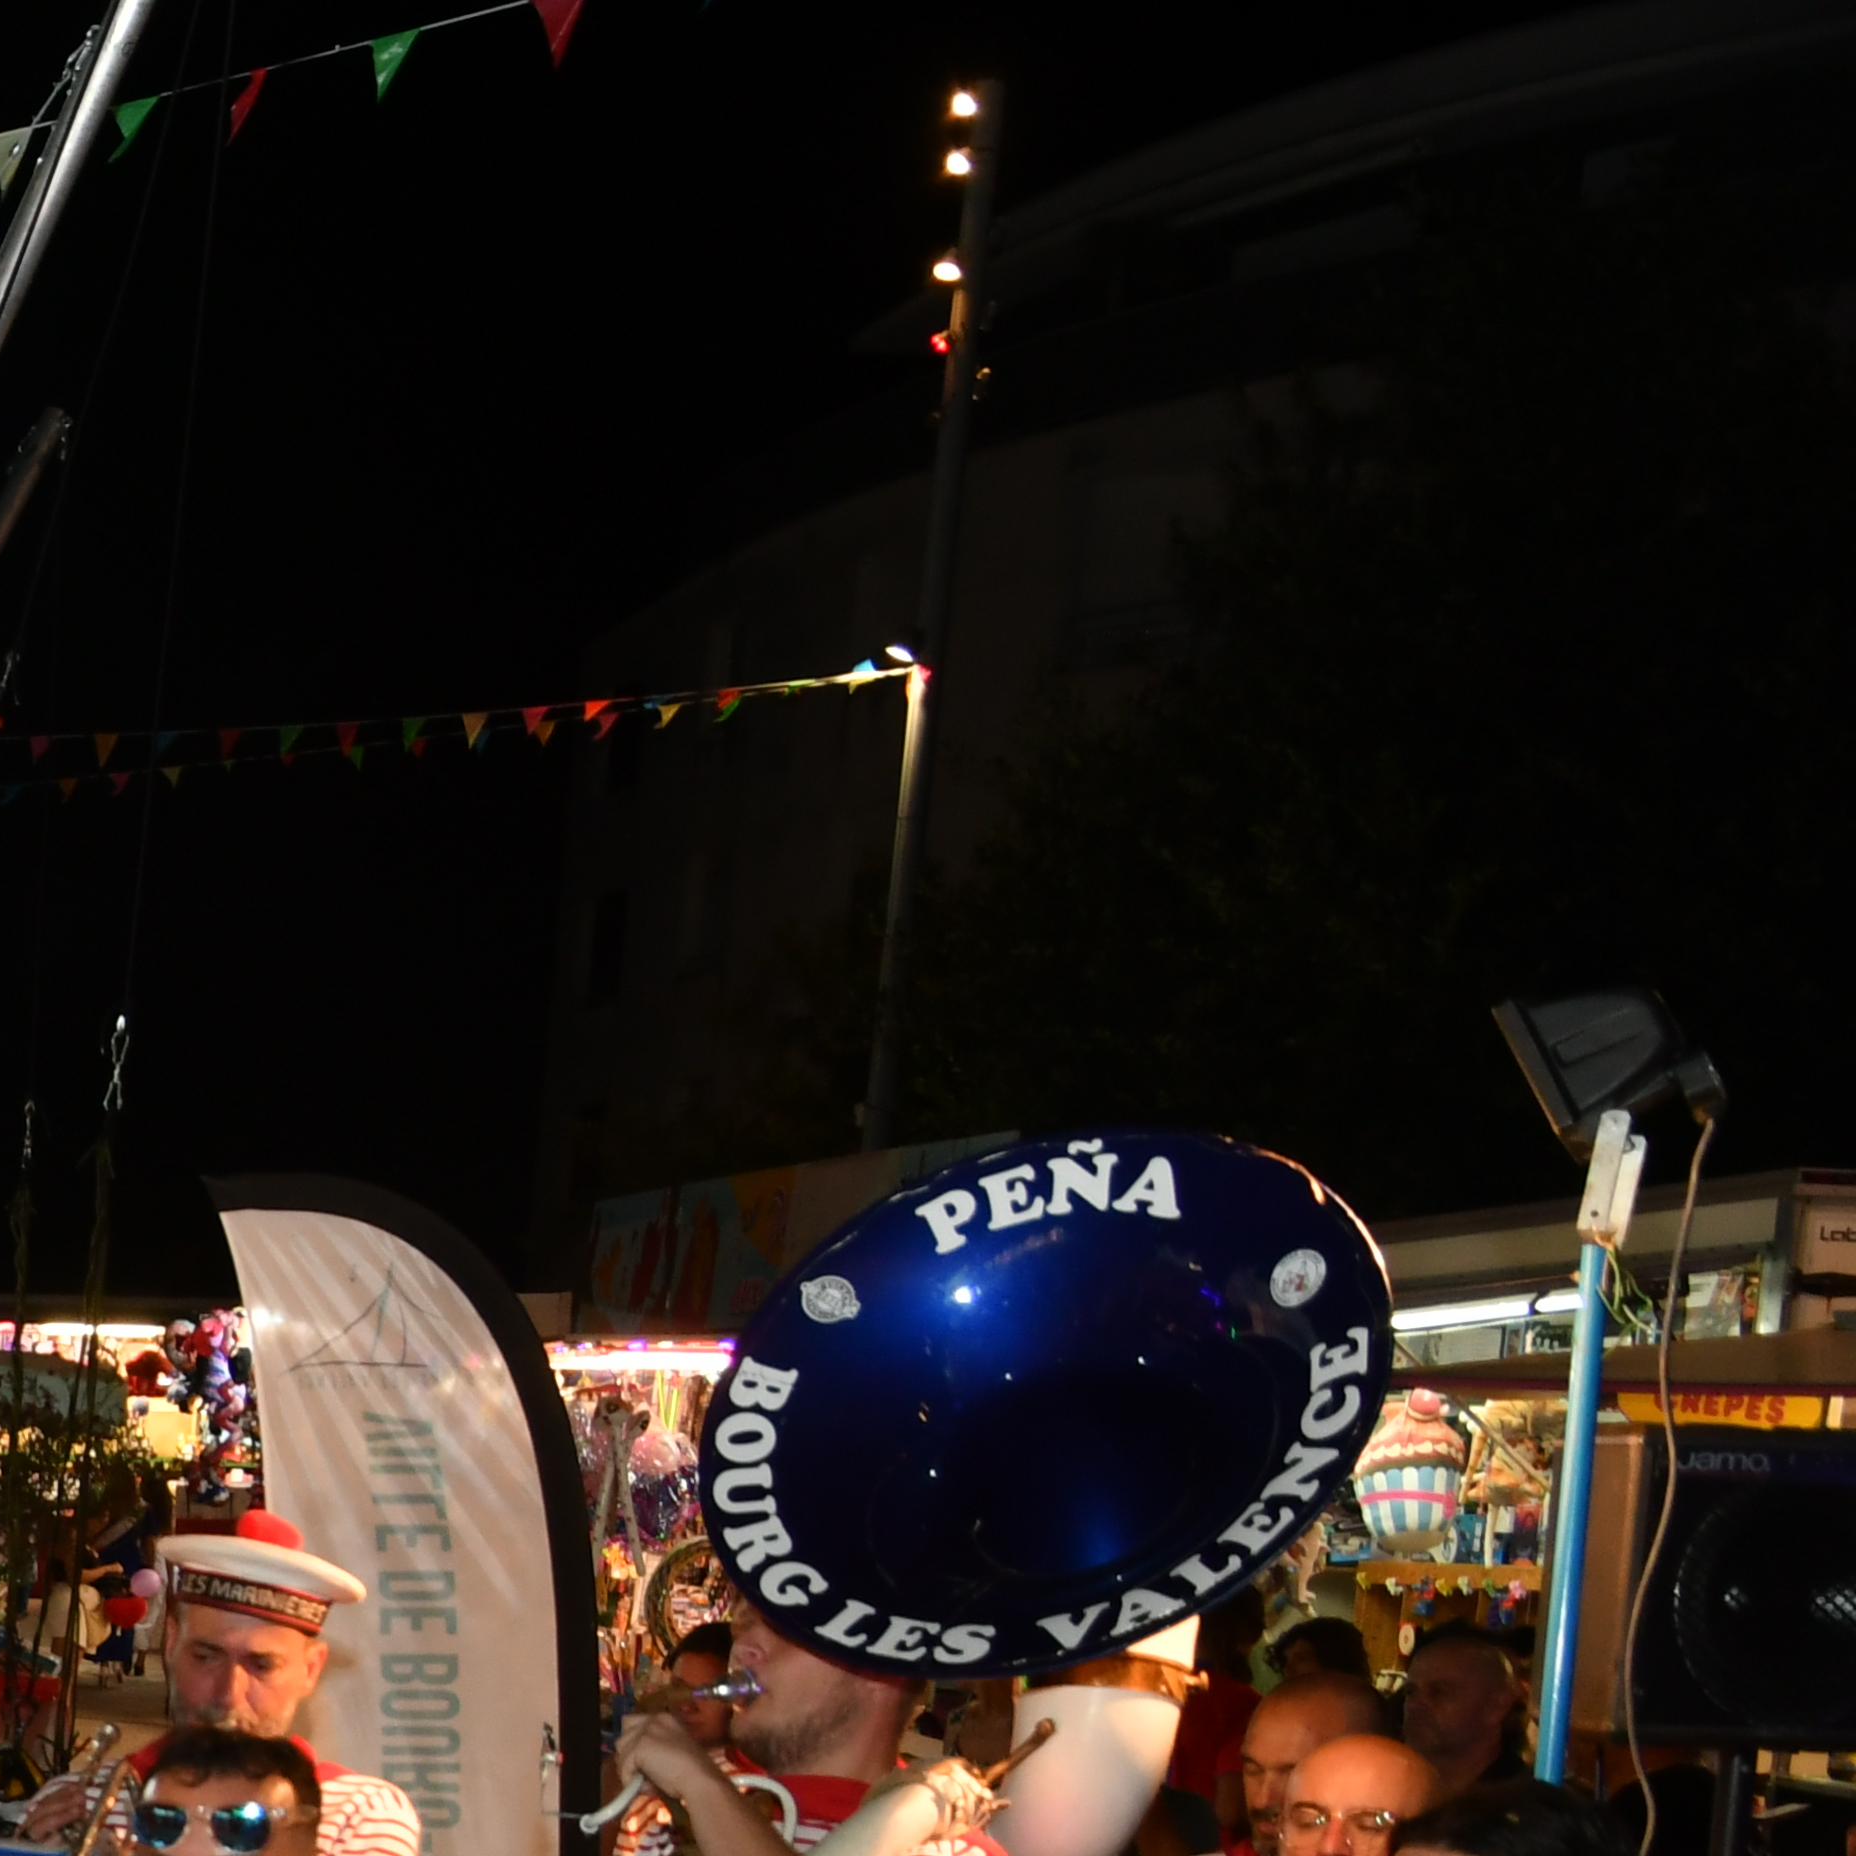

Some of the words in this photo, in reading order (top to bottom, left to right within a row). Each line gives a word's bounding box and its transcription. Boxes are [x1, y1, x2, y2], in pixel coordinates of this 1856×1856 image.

[914, 1138, 1182, 1258] PEÑA
[711, 1355, 830, 1611] BOURG
[815, 1599, 999, 1667] LES
[1035, 1324, 1371, 1653] VALENCE
